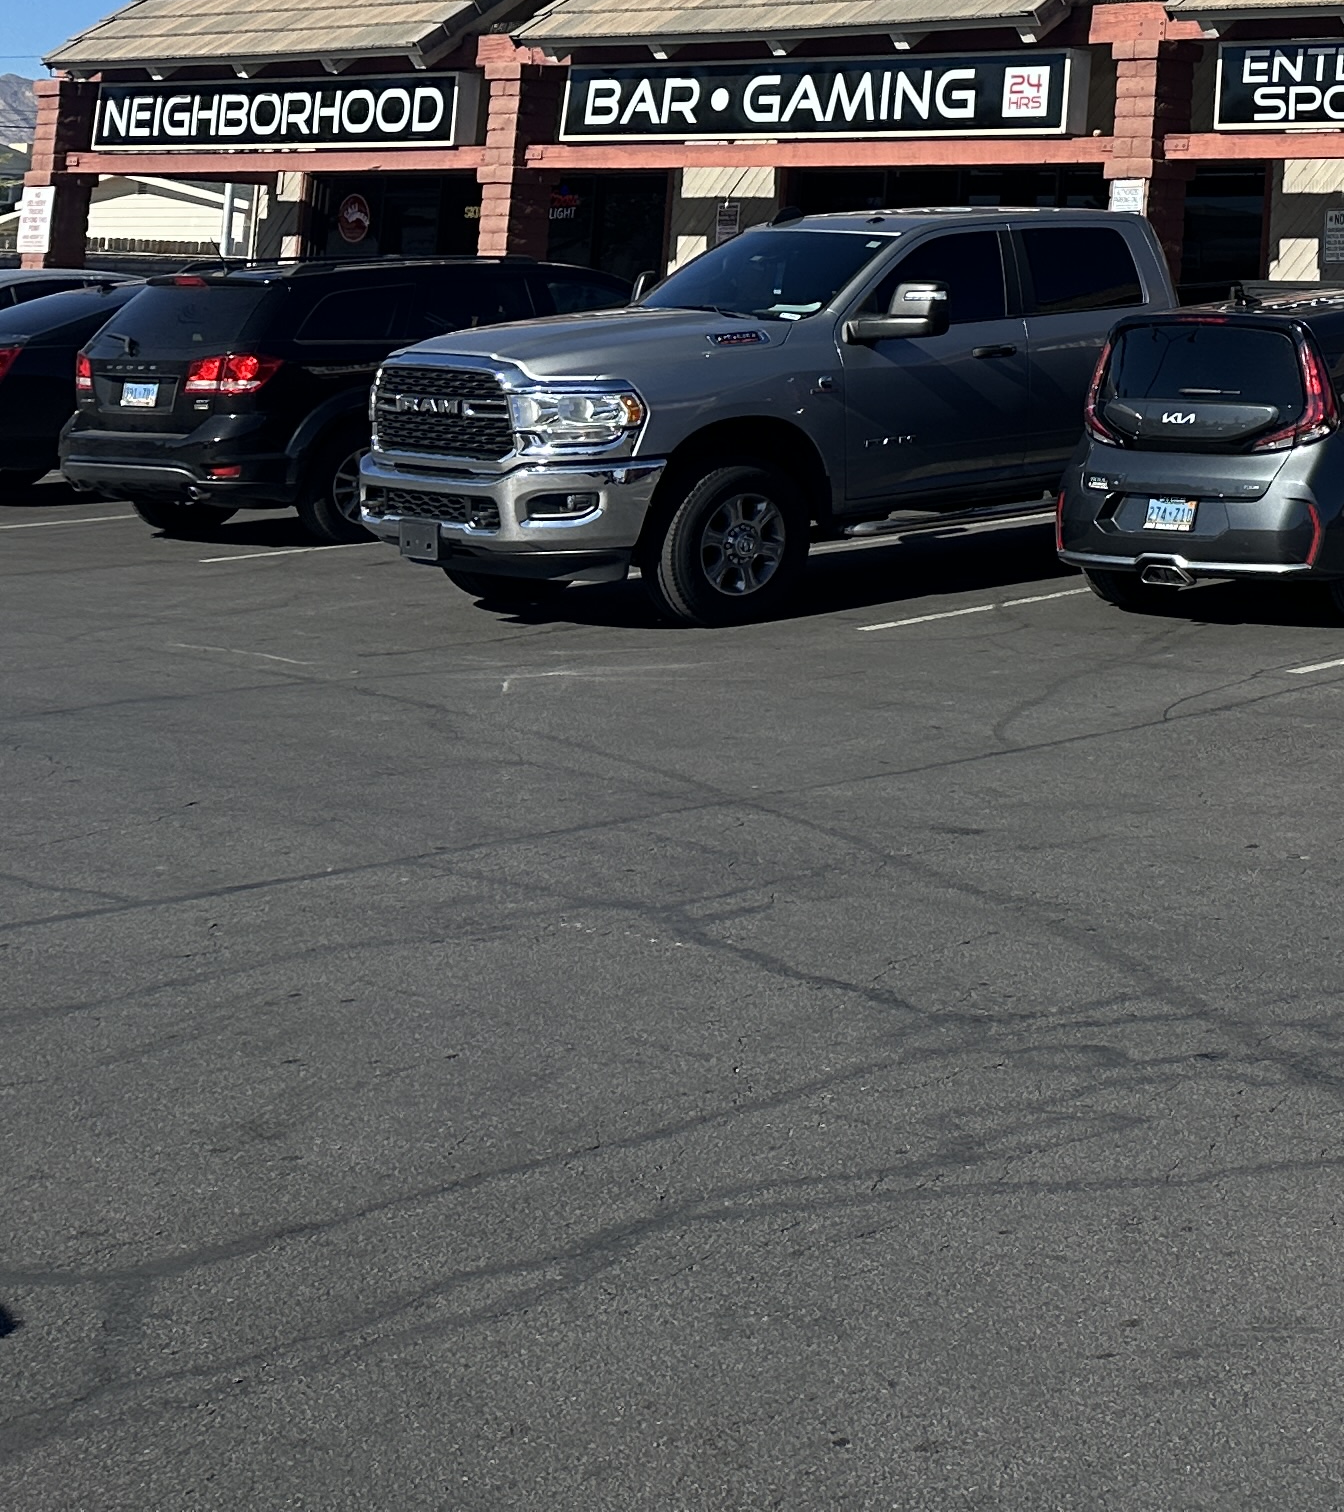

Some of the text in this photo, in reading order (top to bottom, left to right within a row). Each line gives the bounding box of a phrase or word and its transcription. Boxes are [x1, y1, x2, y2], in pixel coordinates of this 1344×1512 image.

[1010, 74, 1043, 94] 24
[584, 68, 976, 126] BAR GAMING
[1008, 95, 1042, 111] HRS
[103, 87, 443, 137] NEIGHBORHOOD
[549, 207, 576, 219] LIGHT
[404, 398, 458, 413] RAM
[1162, 412, 1196, 424] KIA
